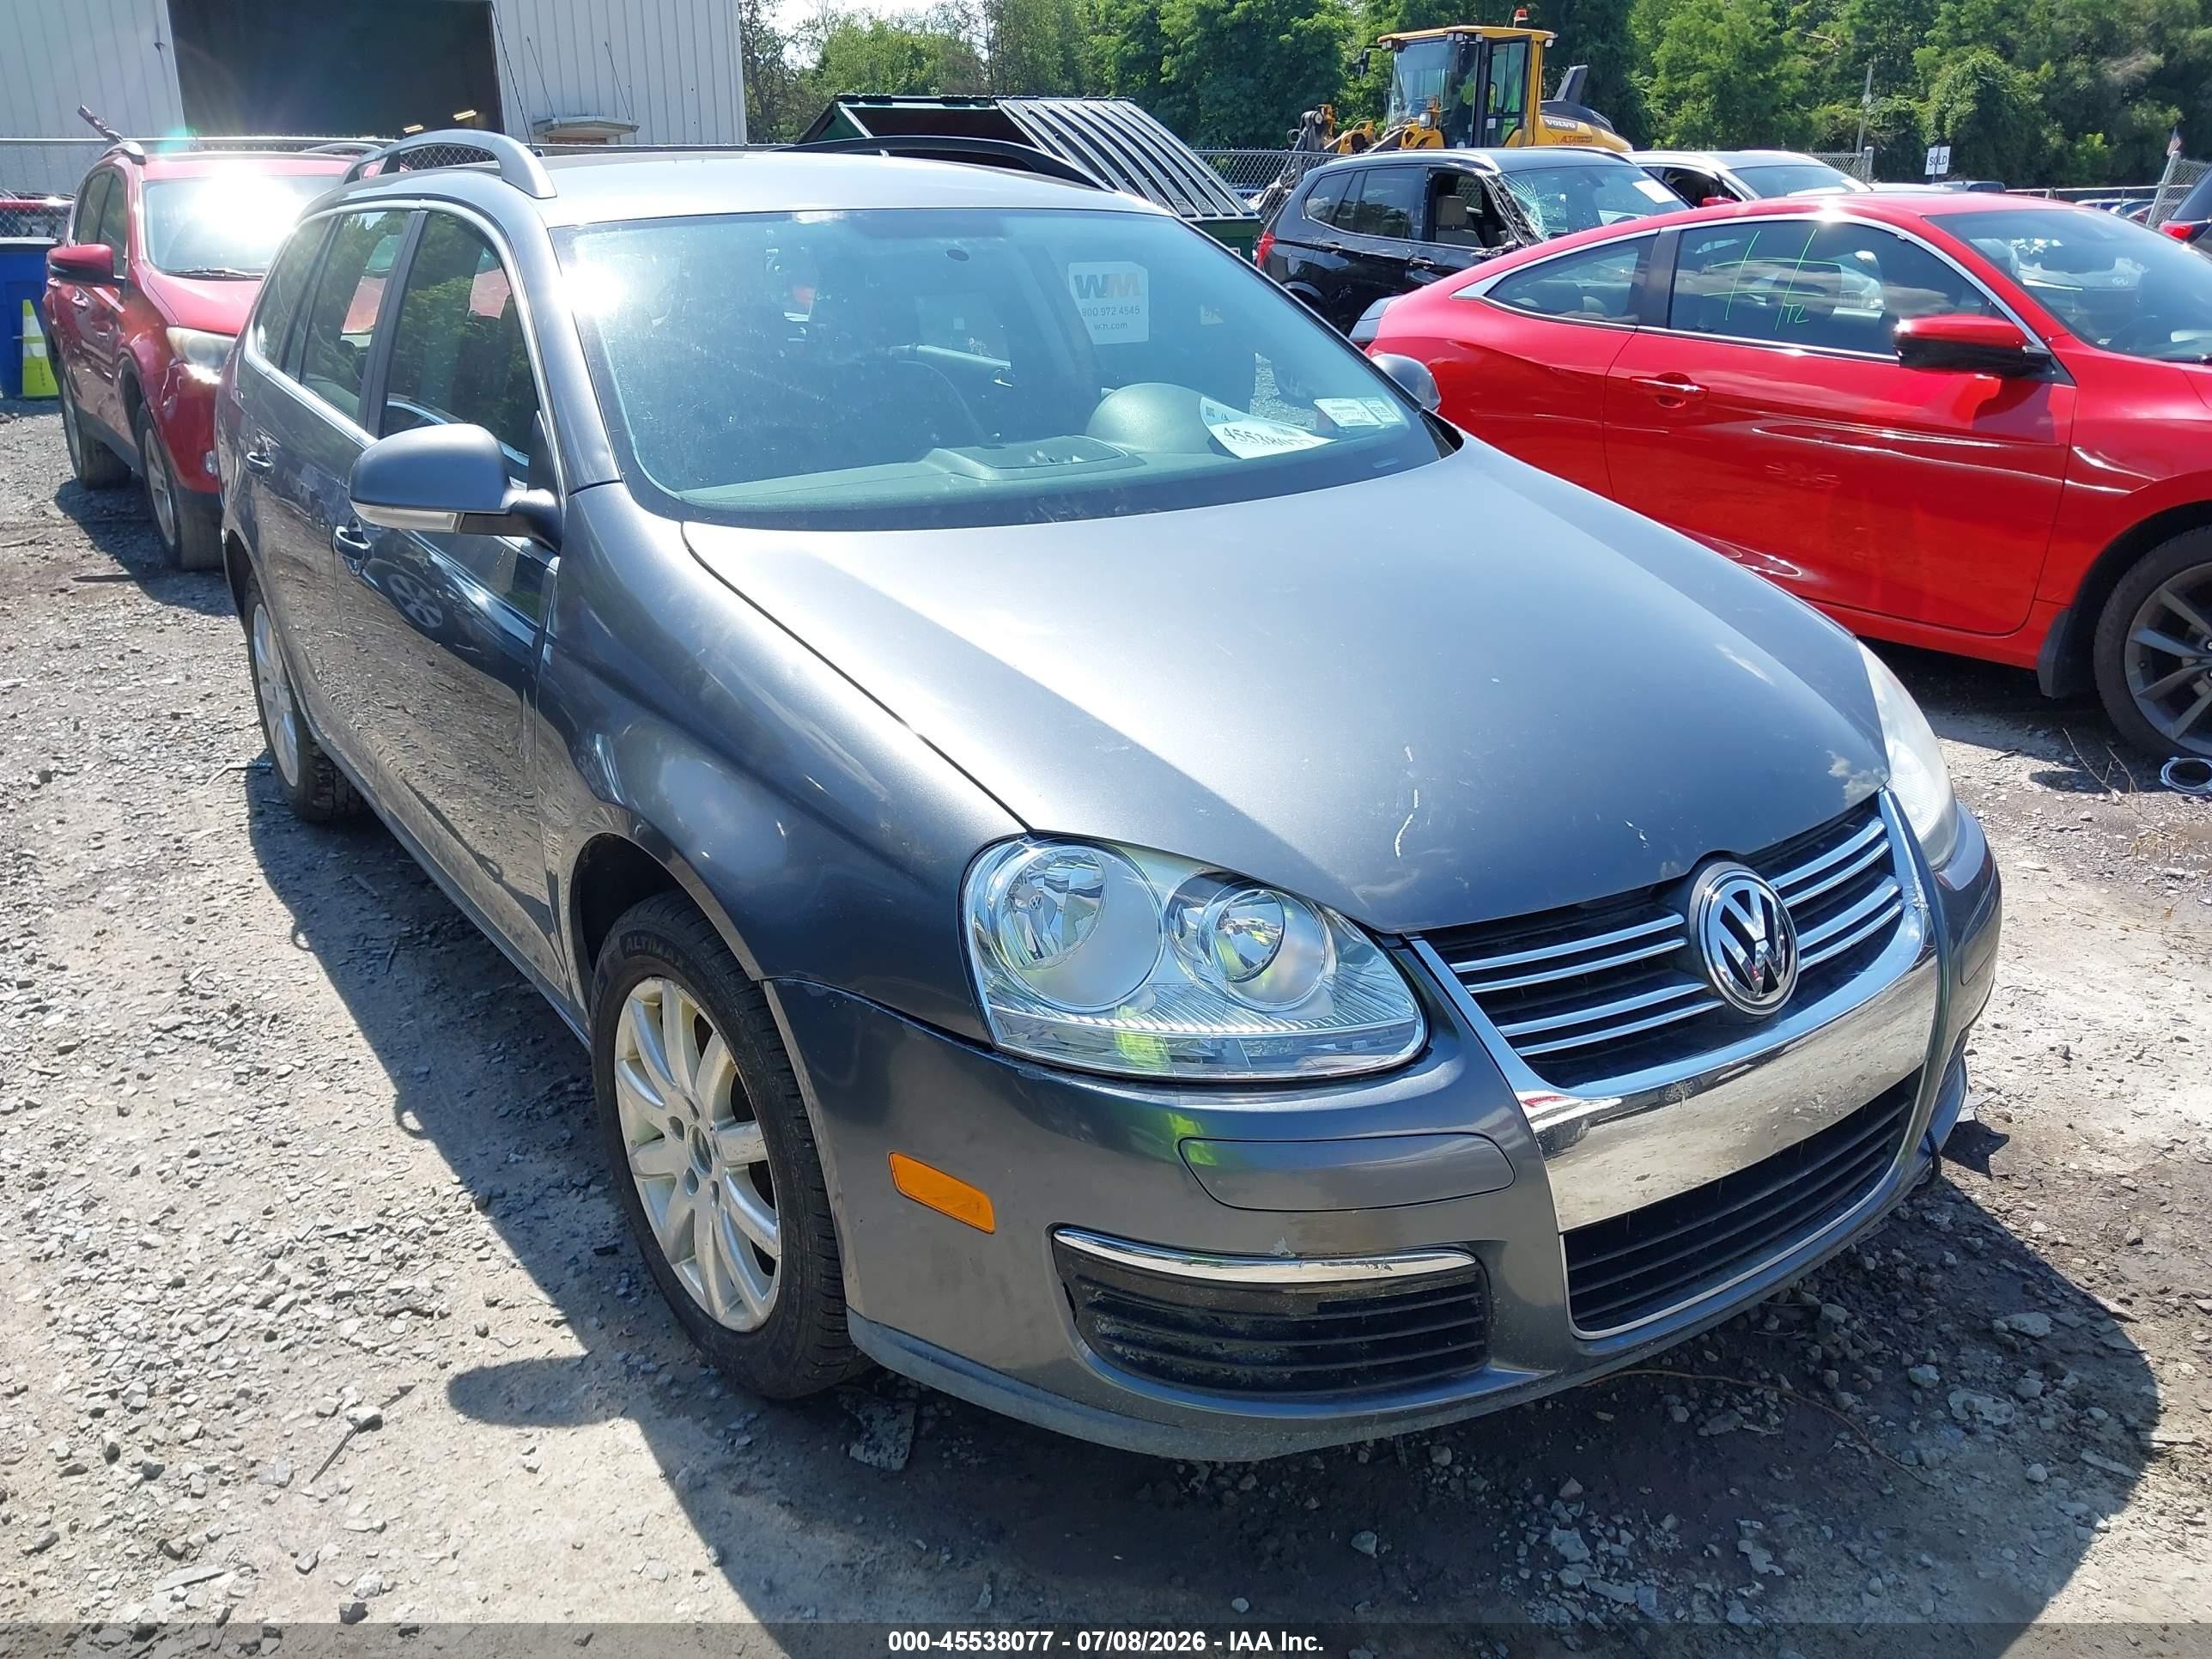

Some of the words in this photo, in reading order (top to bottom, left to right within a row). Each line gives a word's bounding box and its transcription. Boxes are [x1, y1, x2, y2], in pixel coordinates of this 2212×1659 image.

[1546, 119, 1576, 129] VOLVO
[1929, 155, 1948, 167] SOLD
[1074, 273, 1141, 300] WM
[1100, 306, 1117, 316] 972
